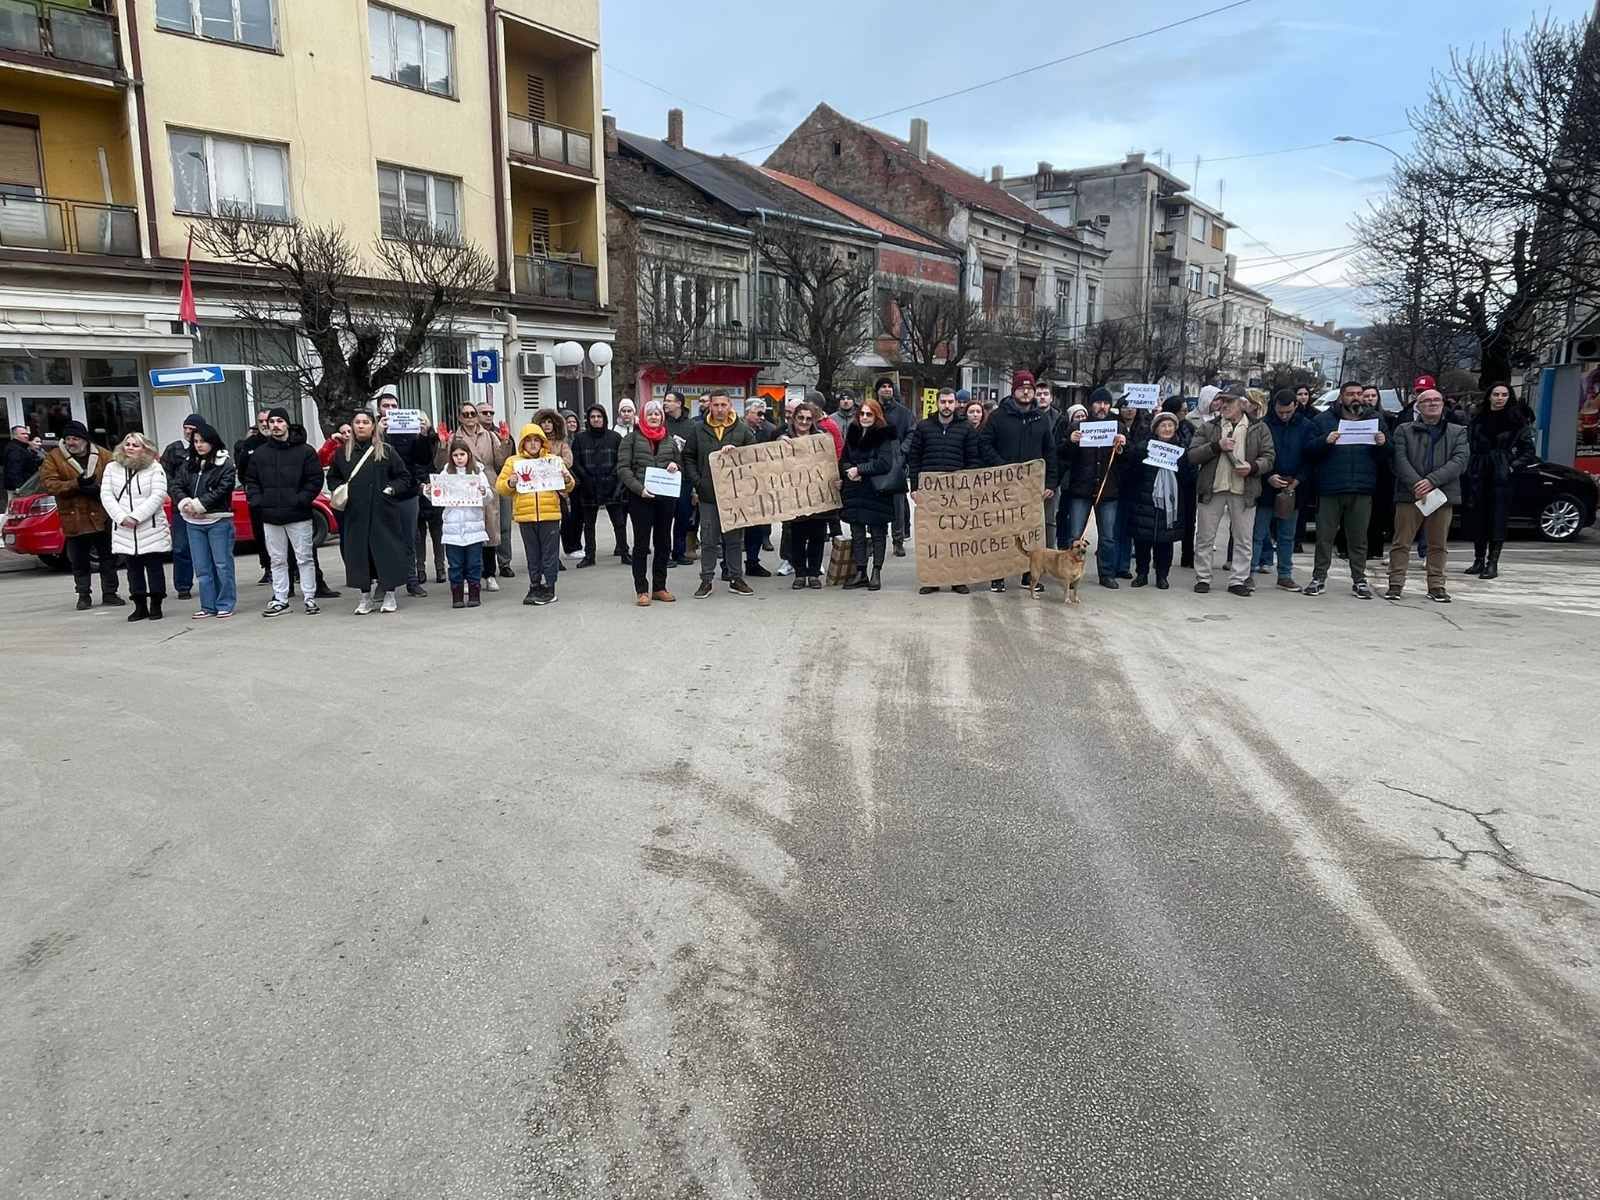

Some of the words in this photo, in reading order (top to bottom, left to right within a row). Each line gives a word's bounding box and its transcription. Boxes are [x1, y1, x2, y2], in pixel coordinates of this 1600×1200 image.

[477, 356, 491, 378] P
[940, 494, 958, 508] ЗА
[969, 488, 1010, 511] ЂАКЕ
[938, 505, 1027, 530] СТУДЕНТЕ
[928, 544, 937, 559] И
